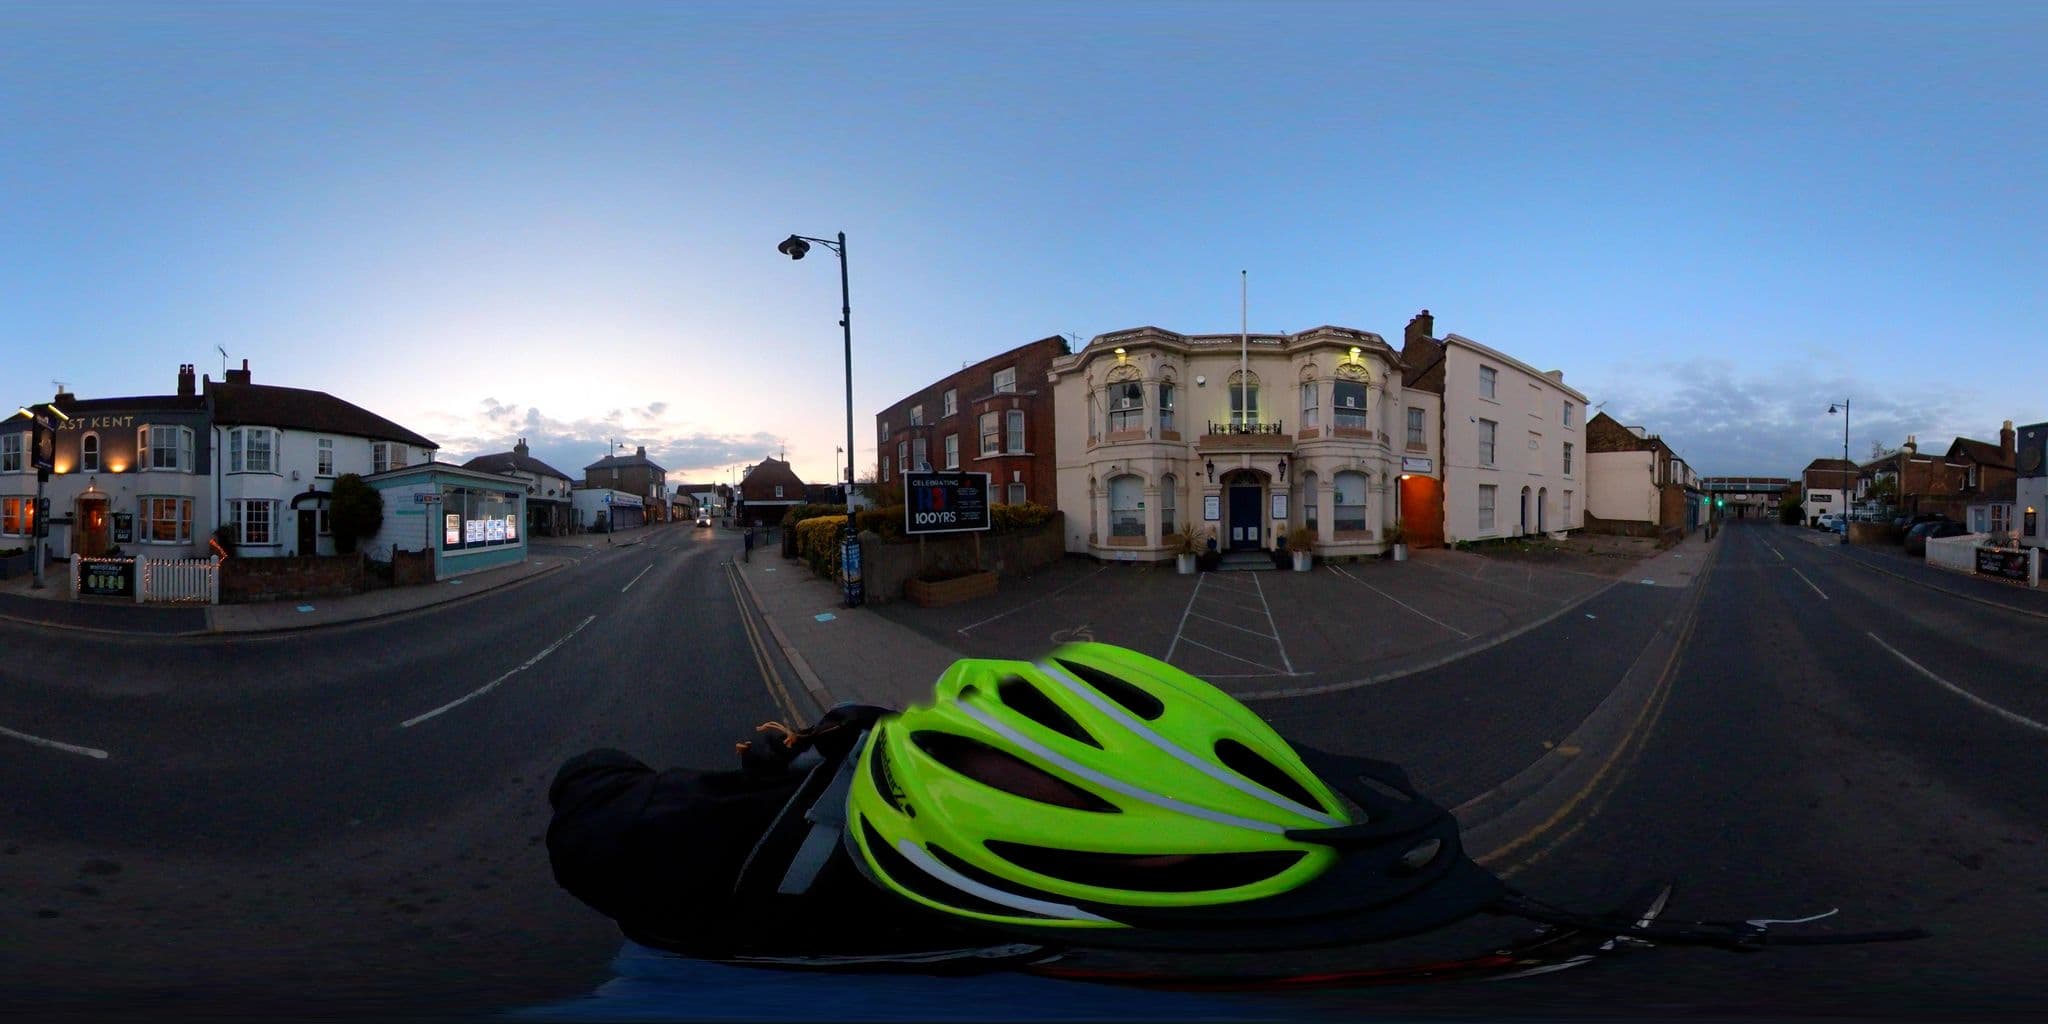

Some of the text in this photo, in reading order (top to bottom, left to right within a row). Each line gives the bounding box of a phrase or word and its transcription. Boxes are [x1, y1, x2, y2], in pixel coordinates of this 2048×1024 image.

[57, 417, 86, 431] AST
[91, 416, 134, 428] KENT
[912, 479, 959, 487] CELEBRATING
